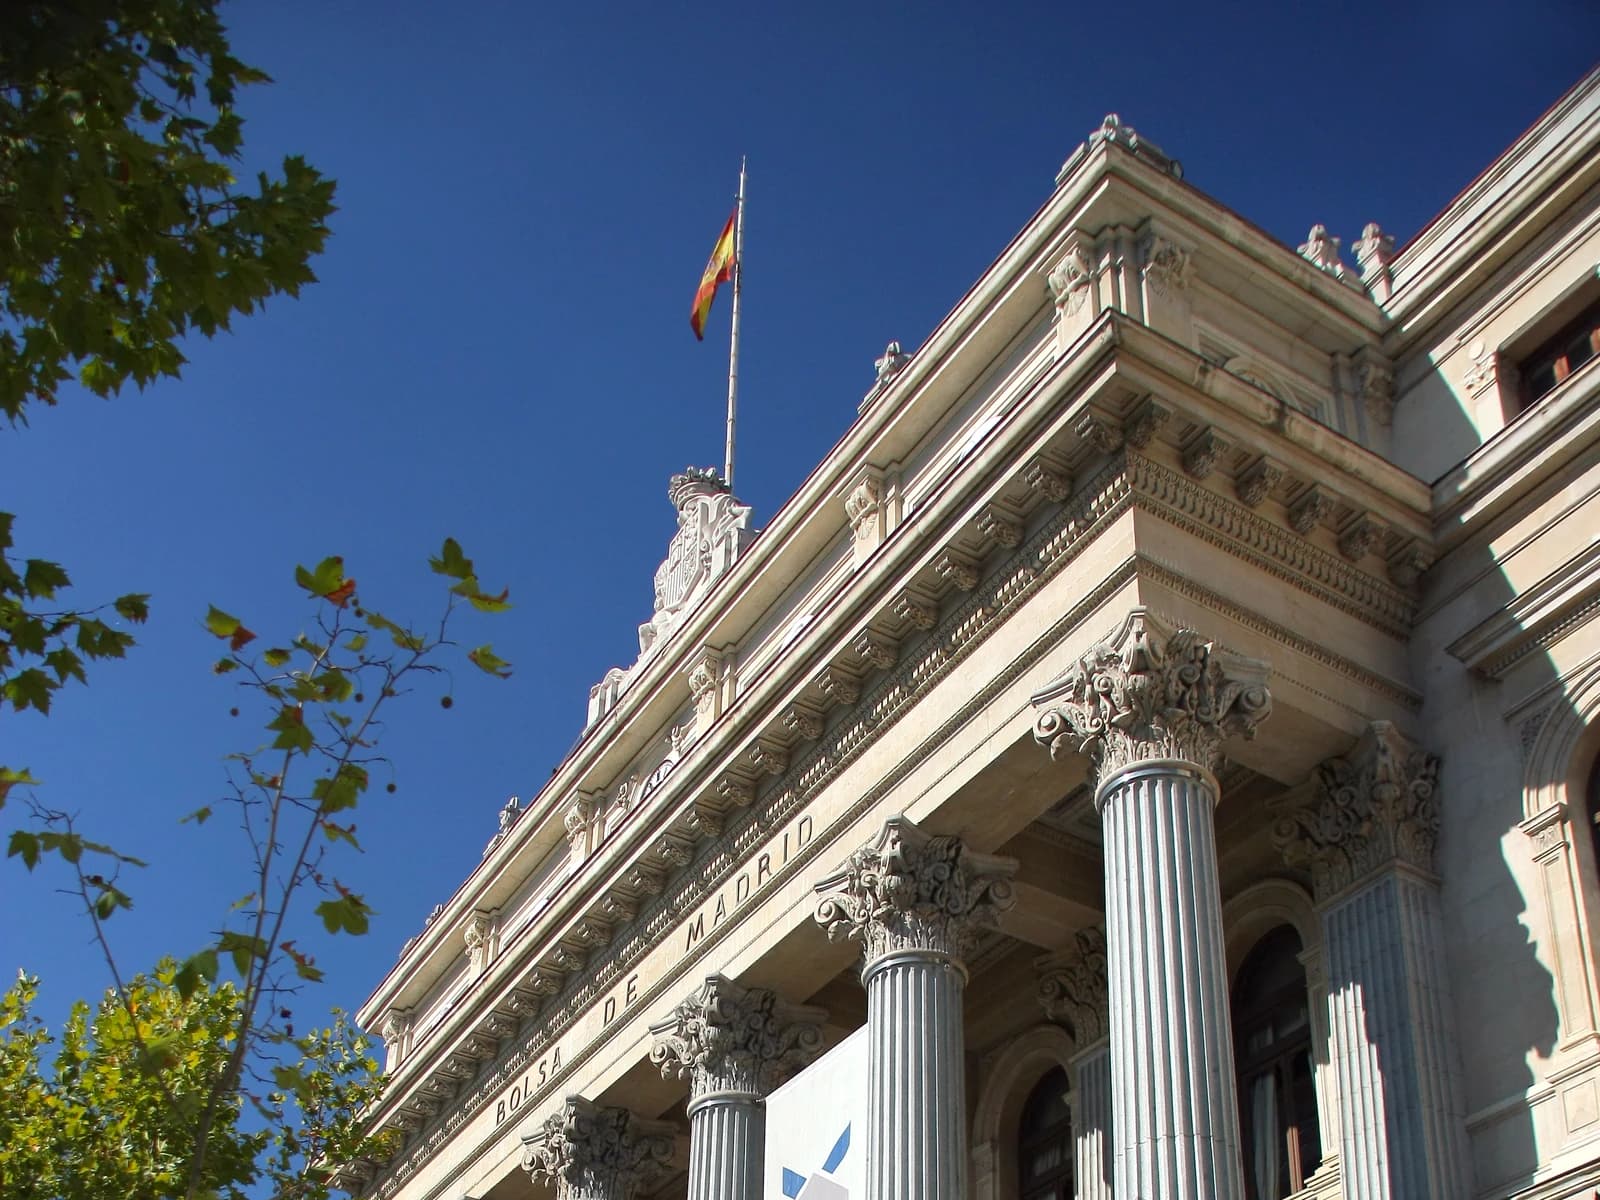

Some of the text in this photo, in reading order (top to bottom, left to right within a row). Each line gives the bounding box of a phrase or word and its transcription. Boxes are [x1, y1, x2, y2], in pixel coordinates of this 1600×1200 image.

[495, 815, 813, 1127] BOLSA DE MADRID
